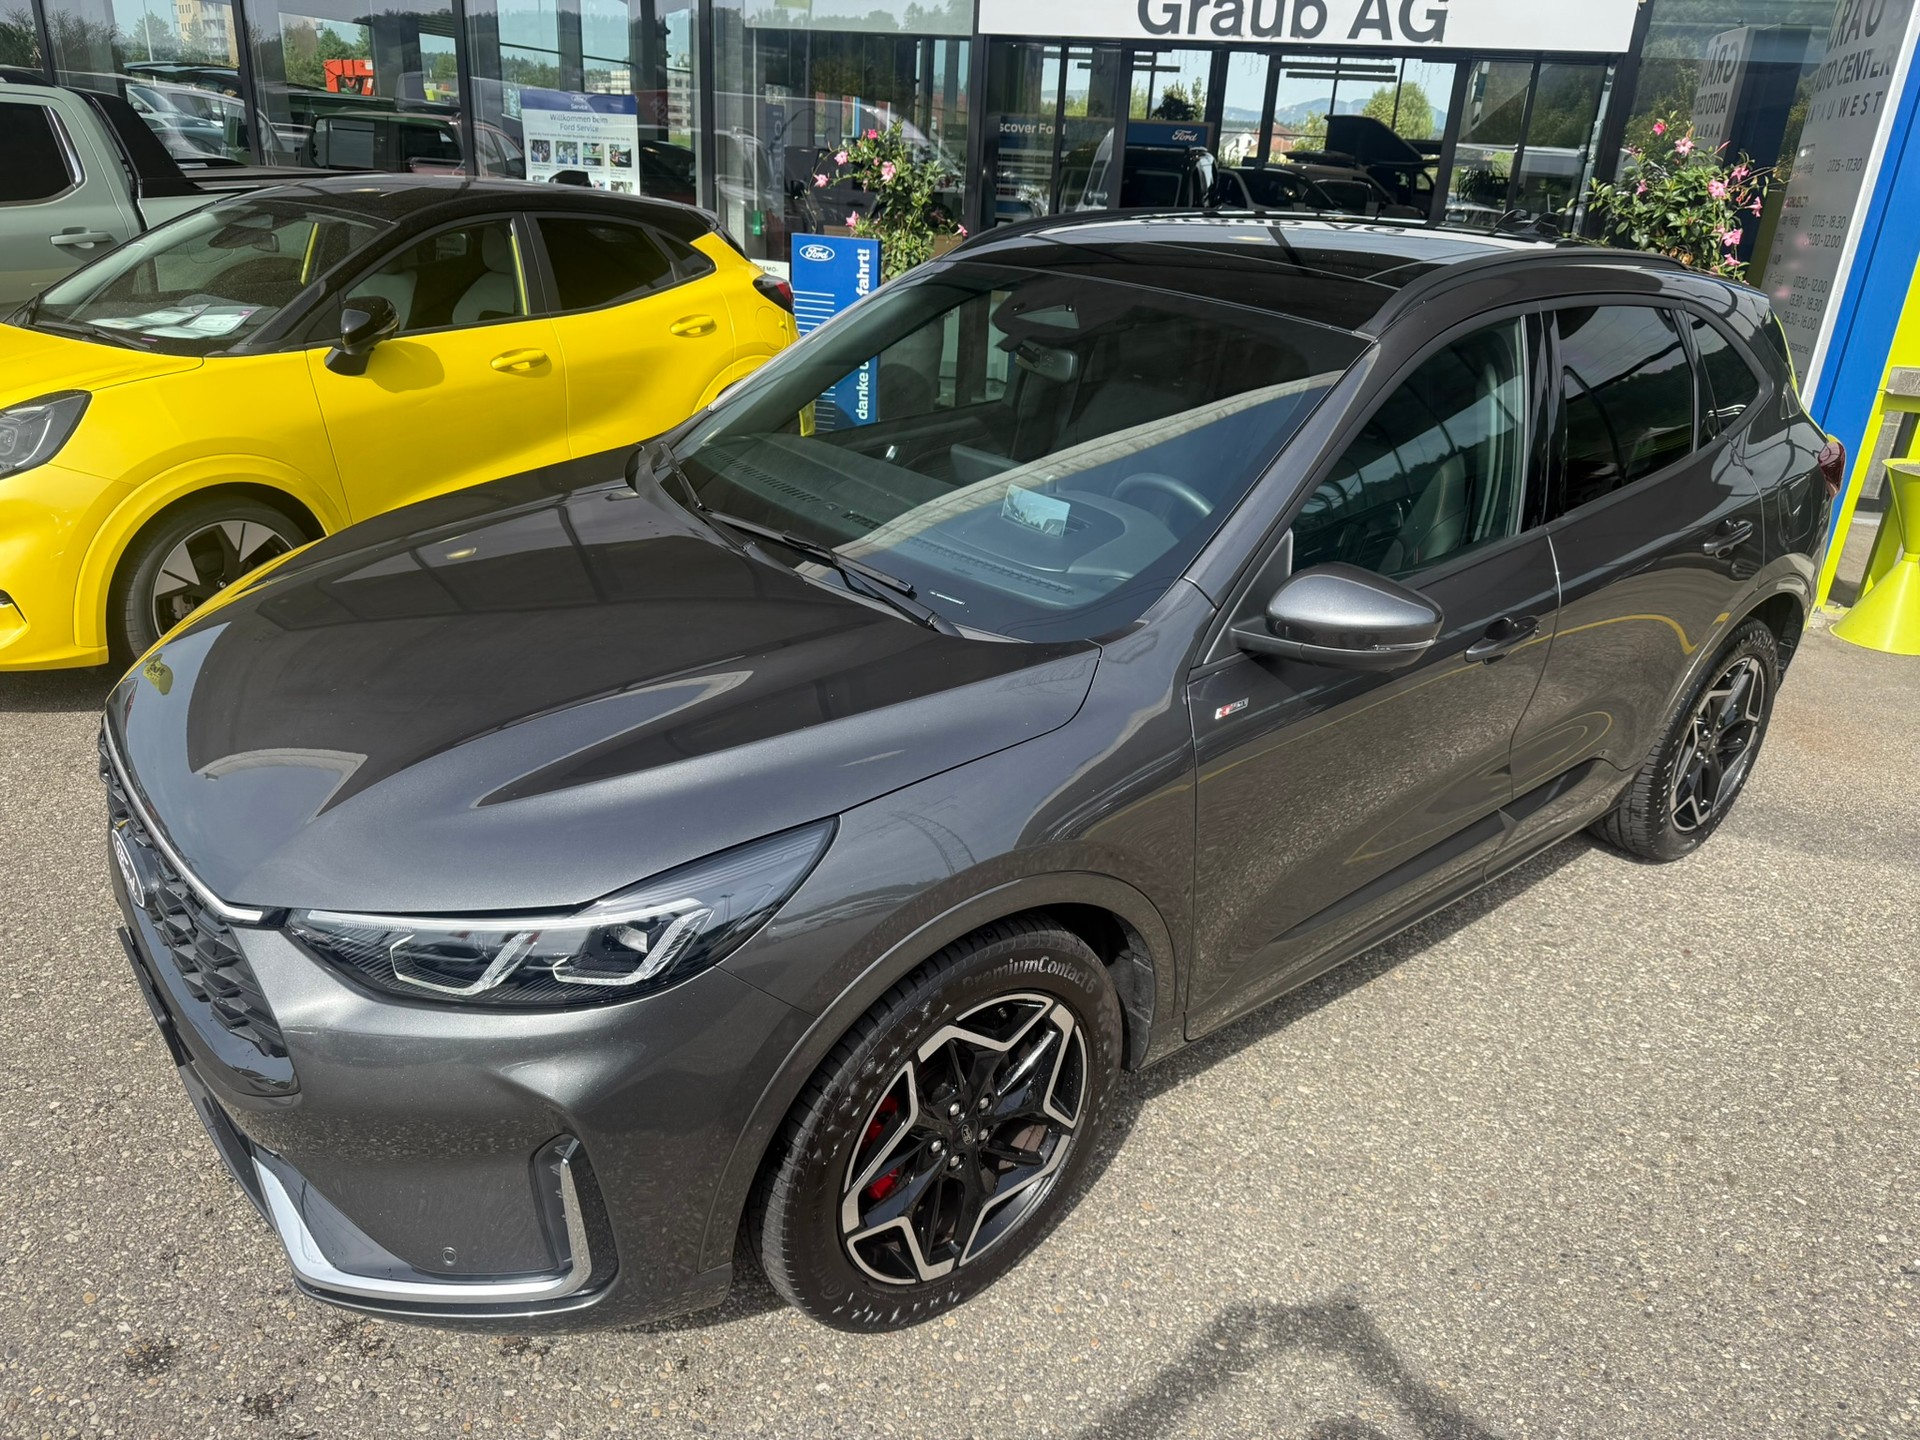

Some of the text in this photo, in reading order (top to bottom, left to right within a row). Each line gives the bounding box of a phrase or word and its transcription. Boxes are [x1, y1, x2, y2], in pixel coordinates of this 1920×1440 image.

[1346, 0, 1450, 43] AG
[1838, 91, 1883, 118] WEST
[549, 113, 608, 124] Willkommen beim
[560, 123, 599, 132] Ford Service
[1171, 129, 1198, 142] Ford
[805, 246, 829, 260] Ford
[856, 248, 870, 296] fahrt!
[856, 372, 869, 420] danke
[1086, 977, 1097, 994] 6
